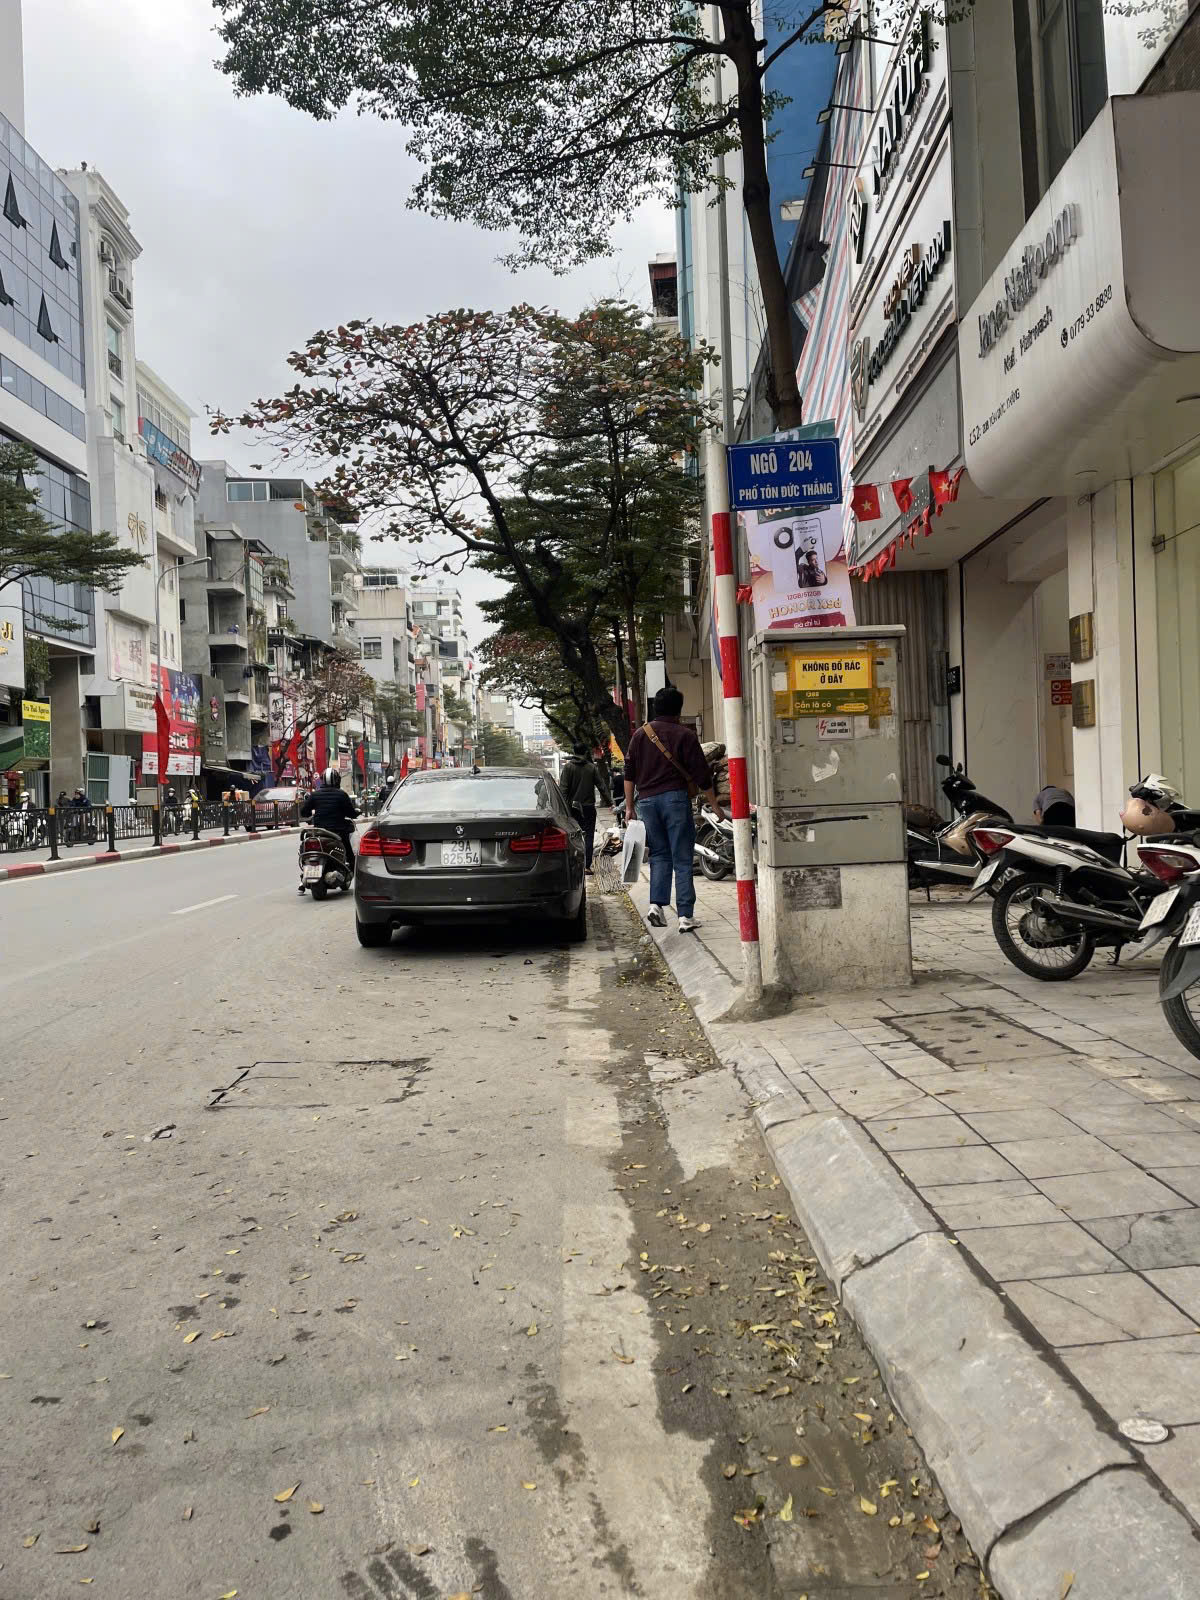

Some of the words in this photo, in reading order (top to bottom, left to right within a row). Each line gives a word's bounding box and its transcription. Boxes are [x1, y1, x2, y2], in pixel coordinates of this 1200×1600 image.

[924, 220, 951, 284] NAM
[1086, 303, 1096, 323] 33
[750, 448, 777, 475] NGÕ
[789, 450, 813, 472] 204
[739, 484, 758, 501] PHỐ
[760, 484, 779, 499] TÔN
[781, 482, 800, 498] ĐỨC
[802, 478, 833, 496] THẮNG
[802, 661, 830, 672] KHÔNG
[831, 658, 843, 671] ĐỔ
[844, 660, 861, 671] RÁC
[820, 673, 827, 684] Ở
[828, 674, 844, 684] ĐÂY
[451, 840, 472, 852] 29A
[443, 852, 479, 865] 825.54
